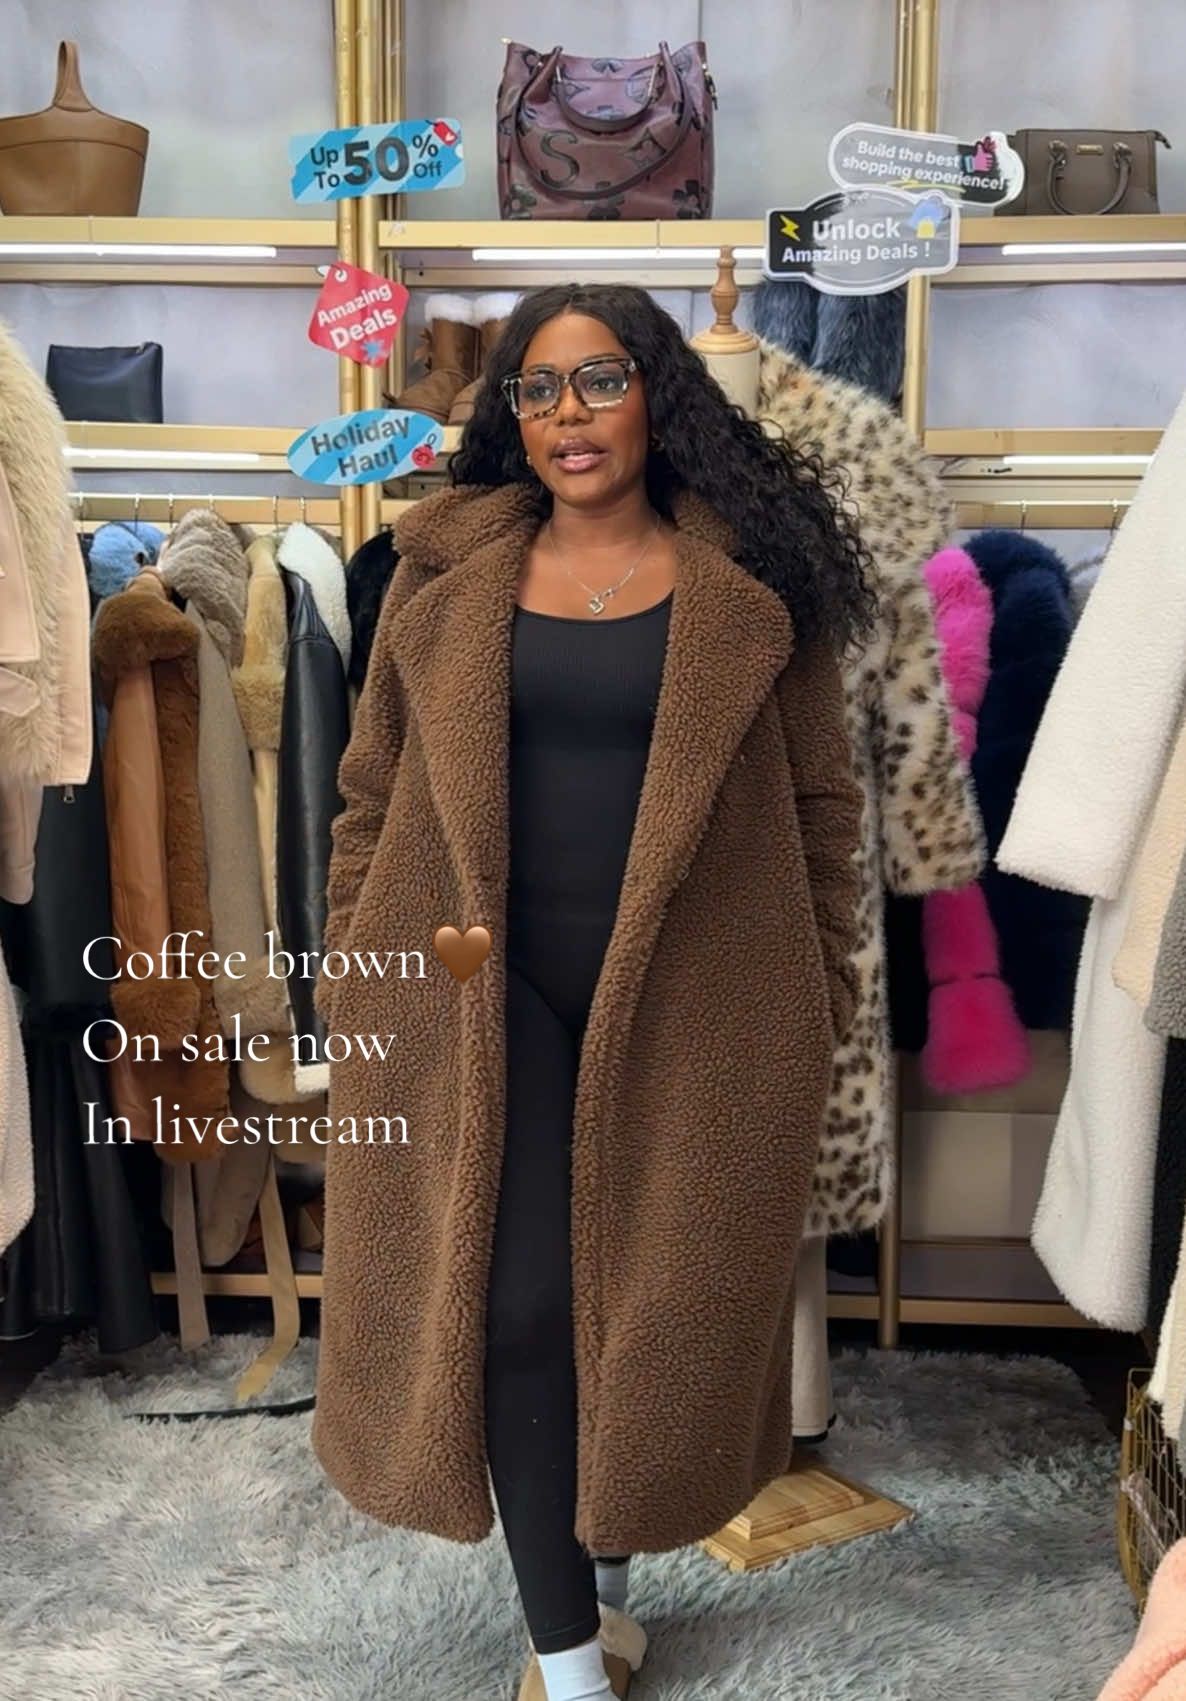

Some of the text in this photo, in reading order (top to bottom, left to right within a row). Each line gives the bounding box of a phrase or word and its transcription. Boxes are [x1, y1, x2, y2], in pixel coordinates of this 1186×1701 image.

[311, 147, 338, 168] Up
[857, 140, 962, 168] Build the best
[314, 171, 341, 189] To
[413, 161, 442, 178] Off
[842, 155, 1005, 191] shopping experience!
[812, 217, 901, 241] Unlock
[782, 246, 863, 264] Amazing
[866, 243, 919, 260] Deals
[317, 284, 392, 326] Amazing
[330, 308, 397, 349] Deals
[311, 416, 410, 455] Holiday
[338, 444, 398, 477] Haul
